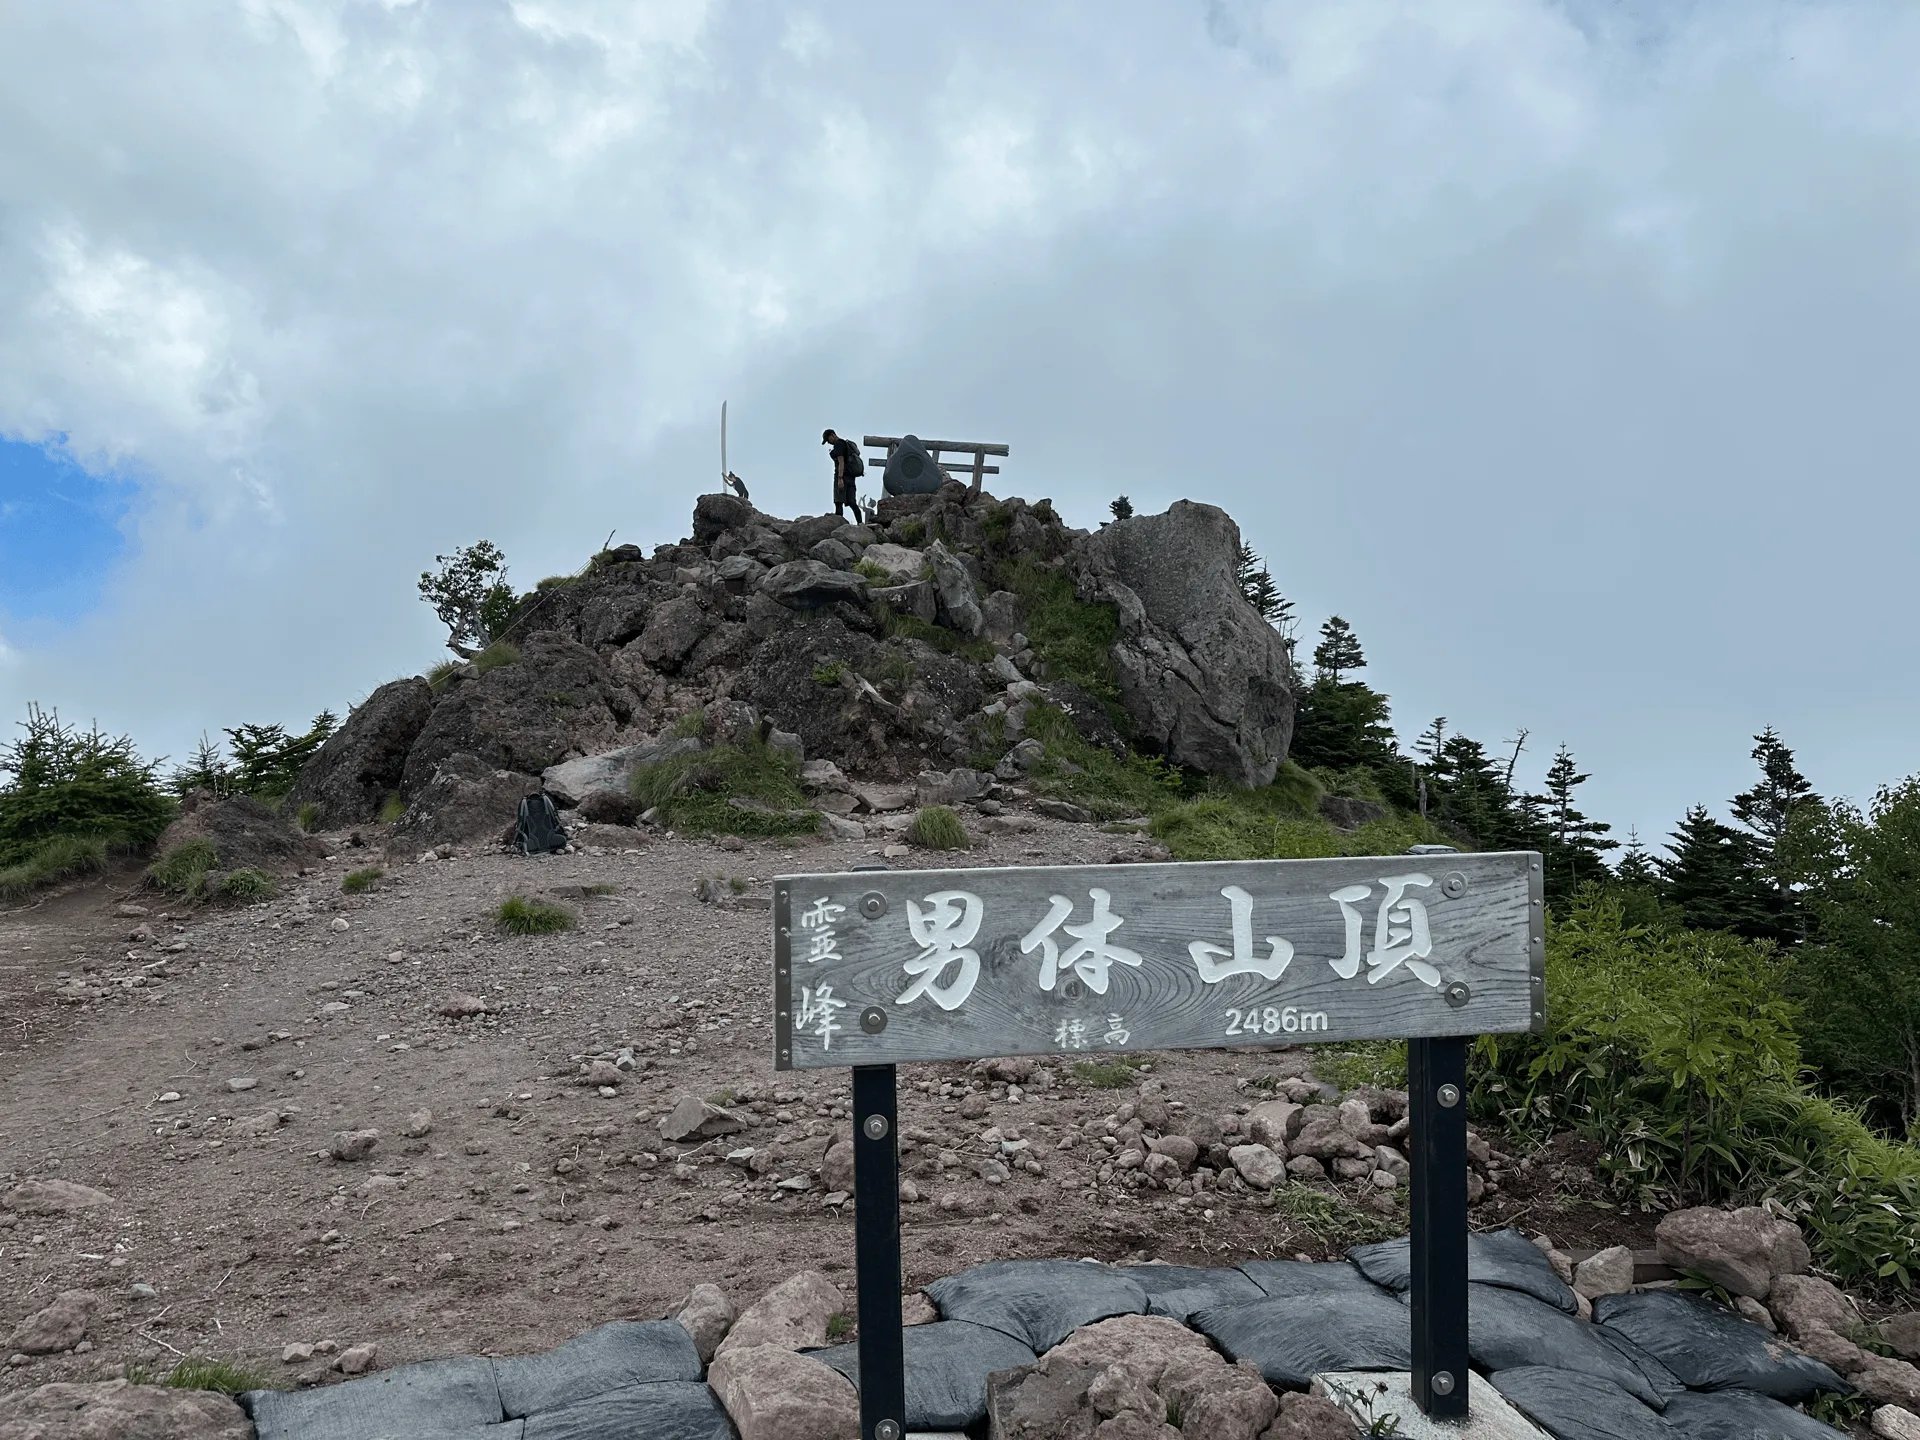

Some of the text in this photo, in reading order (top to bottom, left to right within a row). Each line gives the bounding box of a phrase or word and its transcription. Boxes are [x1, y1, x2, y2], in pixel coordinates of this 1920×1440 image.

[896, 872, 1441, 1011] 男体山頂
[1054, 1006, 1328, 1049] 標高 2486m
